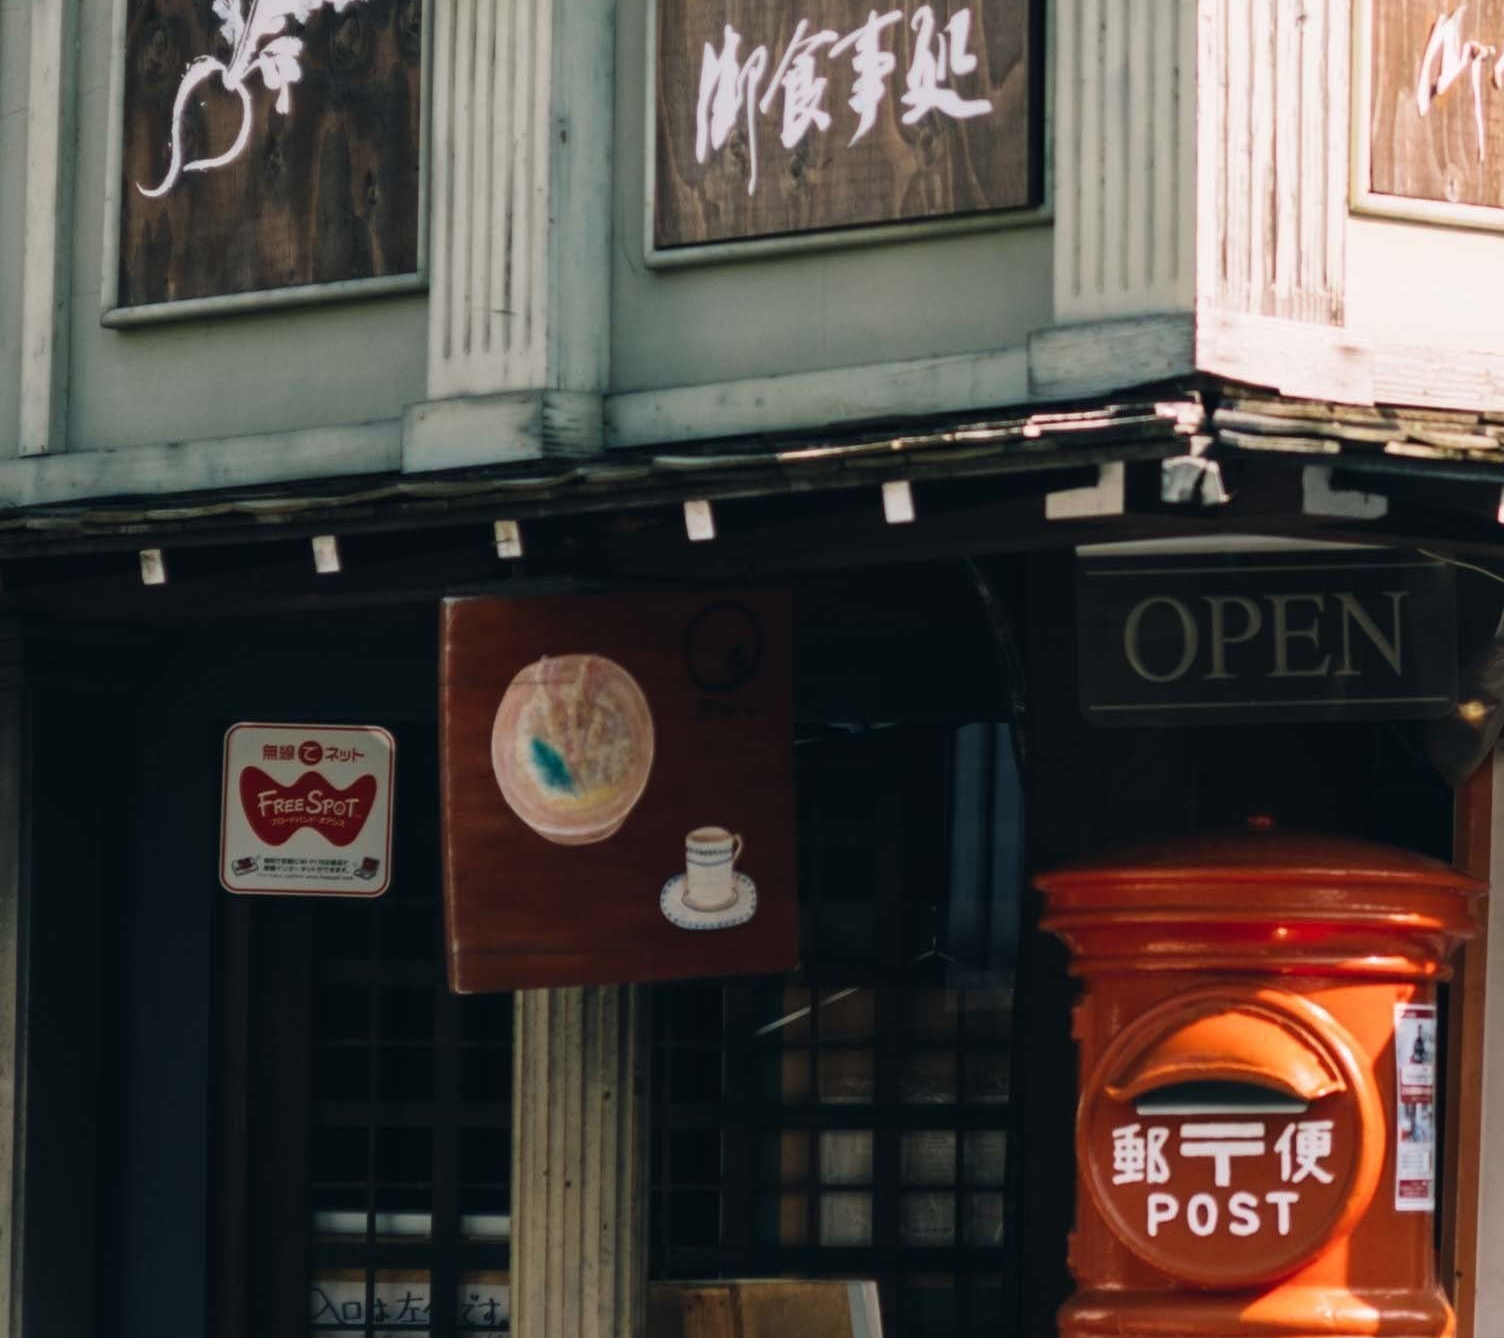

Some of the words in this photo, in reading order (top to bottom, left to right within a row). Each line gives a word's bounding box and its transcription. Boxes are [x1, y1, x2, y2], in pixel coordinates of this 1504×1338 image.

[696, 3, 994, 198] 御食事処
[1122, 590, 1411, 683] OPEN
[262, 742, 365, 764] 無線でネット
[1145, 1191, 1301, 1238] POST
